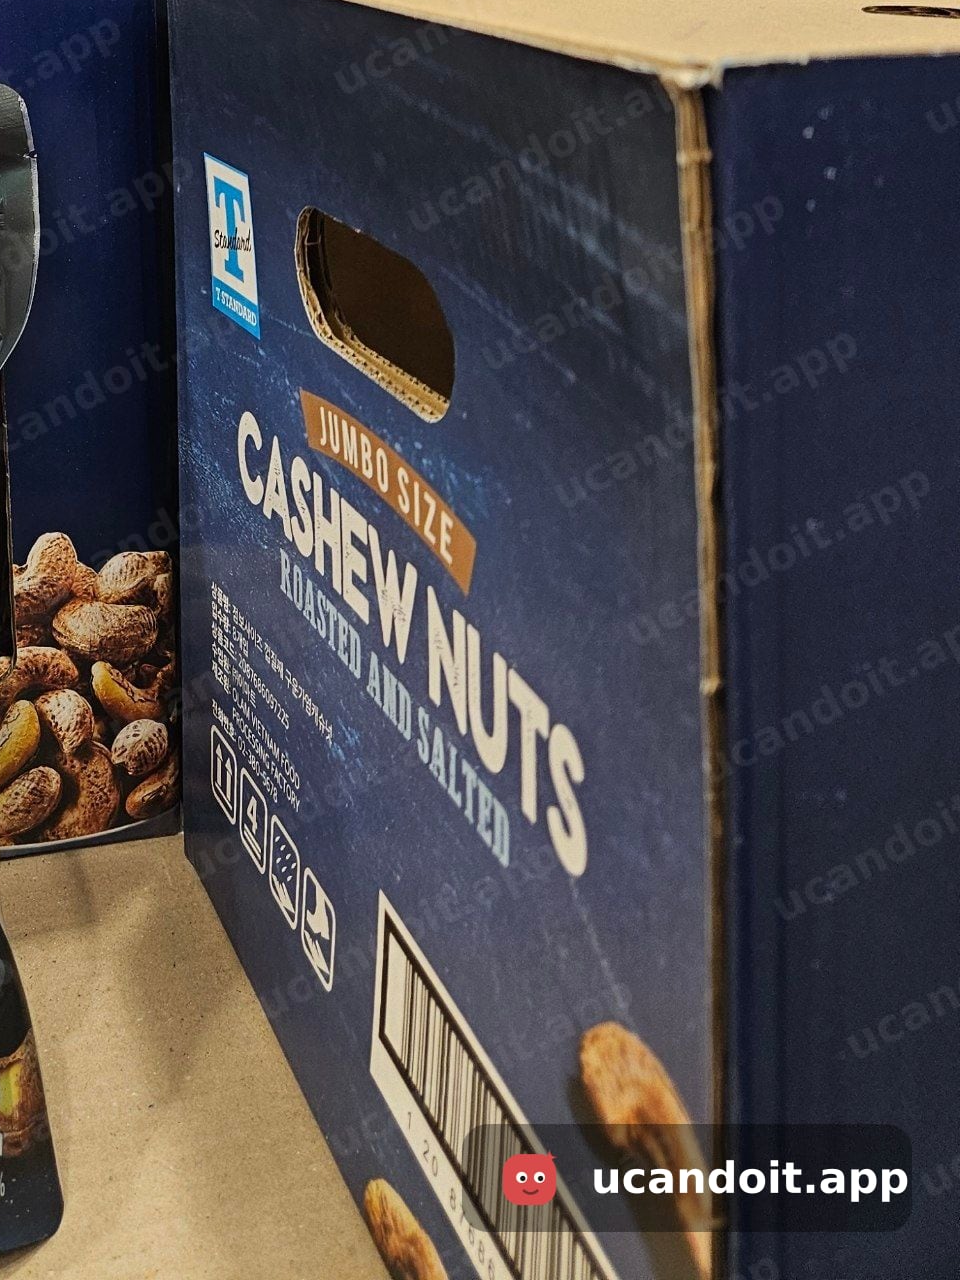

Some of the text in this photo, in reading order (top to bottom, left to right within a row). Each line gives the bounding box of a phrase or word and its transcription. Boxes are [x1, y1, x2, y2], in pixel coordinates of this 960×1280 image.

[214, 227, 252, 252] Standard
[221, 291, 258, 326] STANDARD
[318, 406, 454, 566] JUMBO SIZE
[232, 604, 264, 653] 점보사이즈
[238, 410, 588, 878] CASHEW NUTS
[232, 687, 251, 720] OLAM
[251, 711, 280, 762] VIETNAM
[280, 753, 300, 790] FOOD
[279, 547, 510, 869] ROASTED AND SALTED
[232, 707, 300, 813] PROCESSING FACTORY
[237, 735, 278, 803] 02-380-5678
